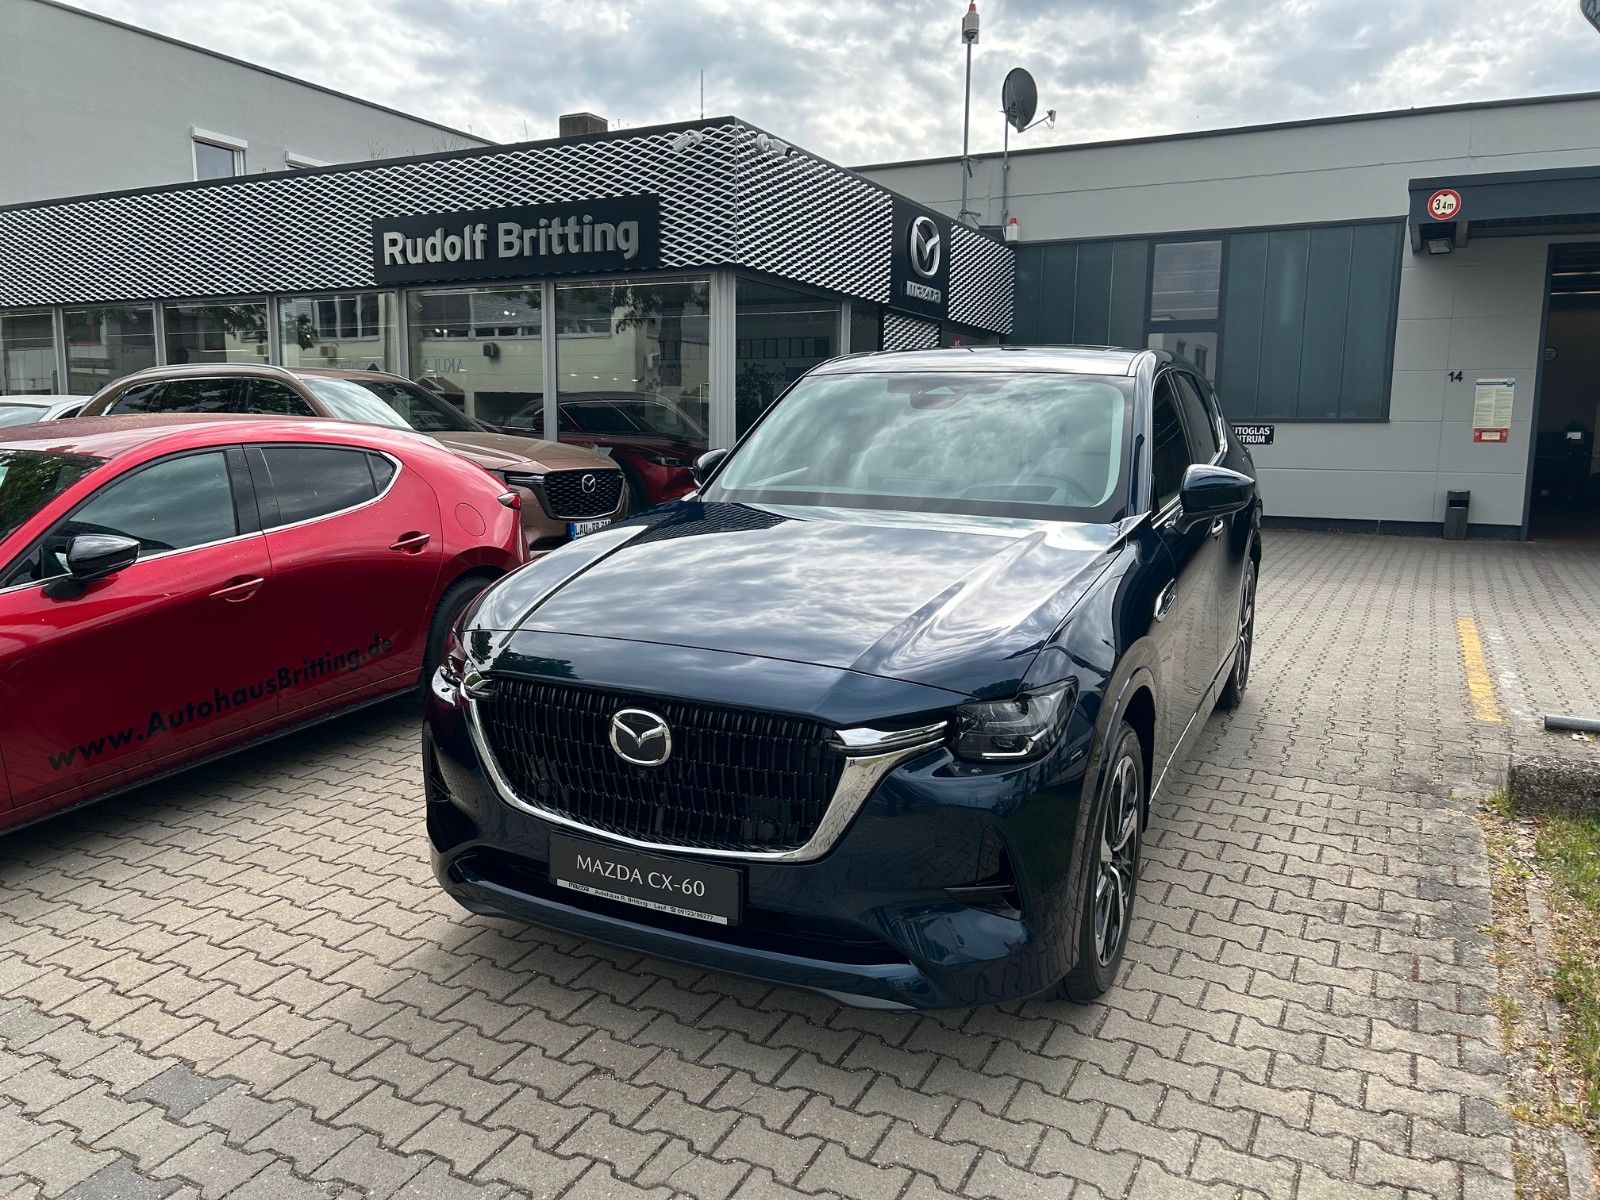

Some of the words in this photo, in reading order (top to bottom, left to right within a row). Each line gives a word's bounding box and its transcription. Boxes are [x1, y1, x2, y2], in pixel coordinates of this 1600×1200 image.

[383, 223, 487, 266] Rudolf
[497, 214, 639, 260] Britting
[1448, 371, 1463, 383] 14
[48, 633, 393, 770] www.AutohausBritting.de
[576, 854, 643, 885] MAZDA
[648, 872, 705, 897] CX-60
[594, 890, 620, 901] Autohaus
[628, 897, 648, 908] Britting
